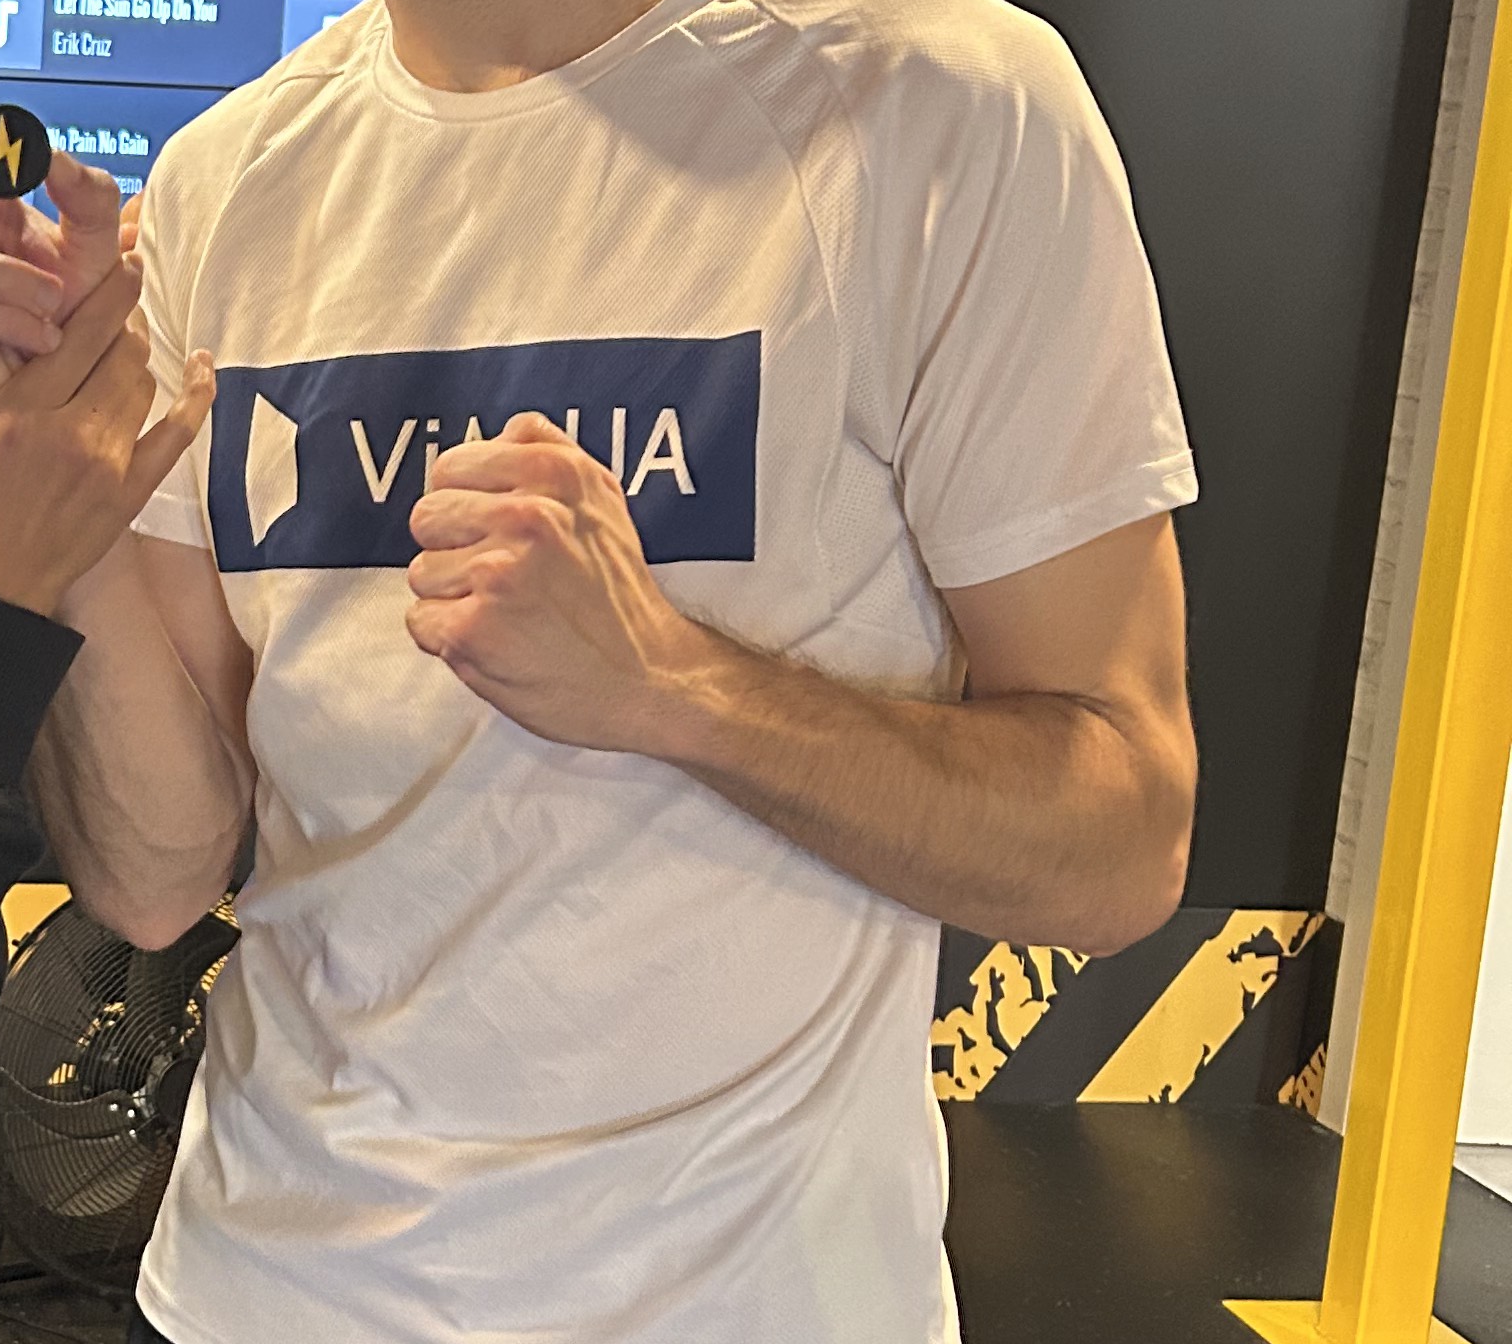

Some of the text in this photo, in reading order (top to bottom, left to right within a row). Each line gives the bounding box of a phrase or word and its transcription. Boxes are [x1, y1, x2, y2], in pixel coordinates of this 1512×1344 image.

[53, 29, 112, 57] Erik Cruz
[67, 128, 97, 154] Pain
[97, 128, 117, 155] No
[117, 129, 149, 156] Gain
